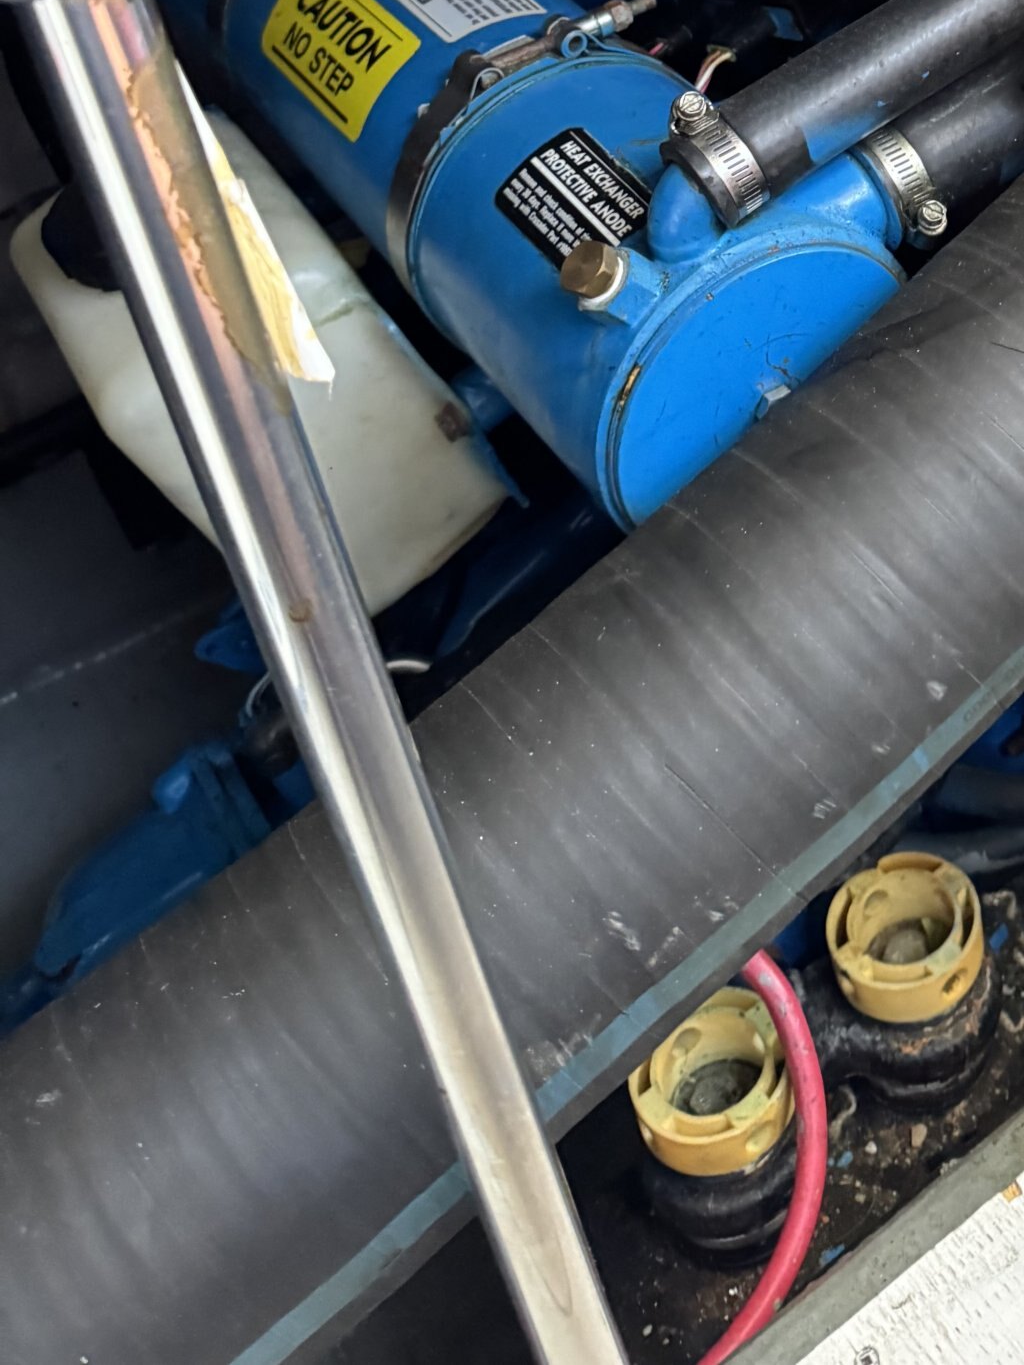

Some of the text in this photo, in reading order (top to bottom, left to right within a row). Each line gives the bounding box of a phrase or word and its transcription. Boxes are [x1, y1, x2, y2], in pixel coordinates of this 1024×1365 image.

[283, 21, 354, 96] NO STEP
[540, 148, 632, 237] PROTECTIVE ANODE
[560, 140, 645, 219] HEAT EXCHANGER
